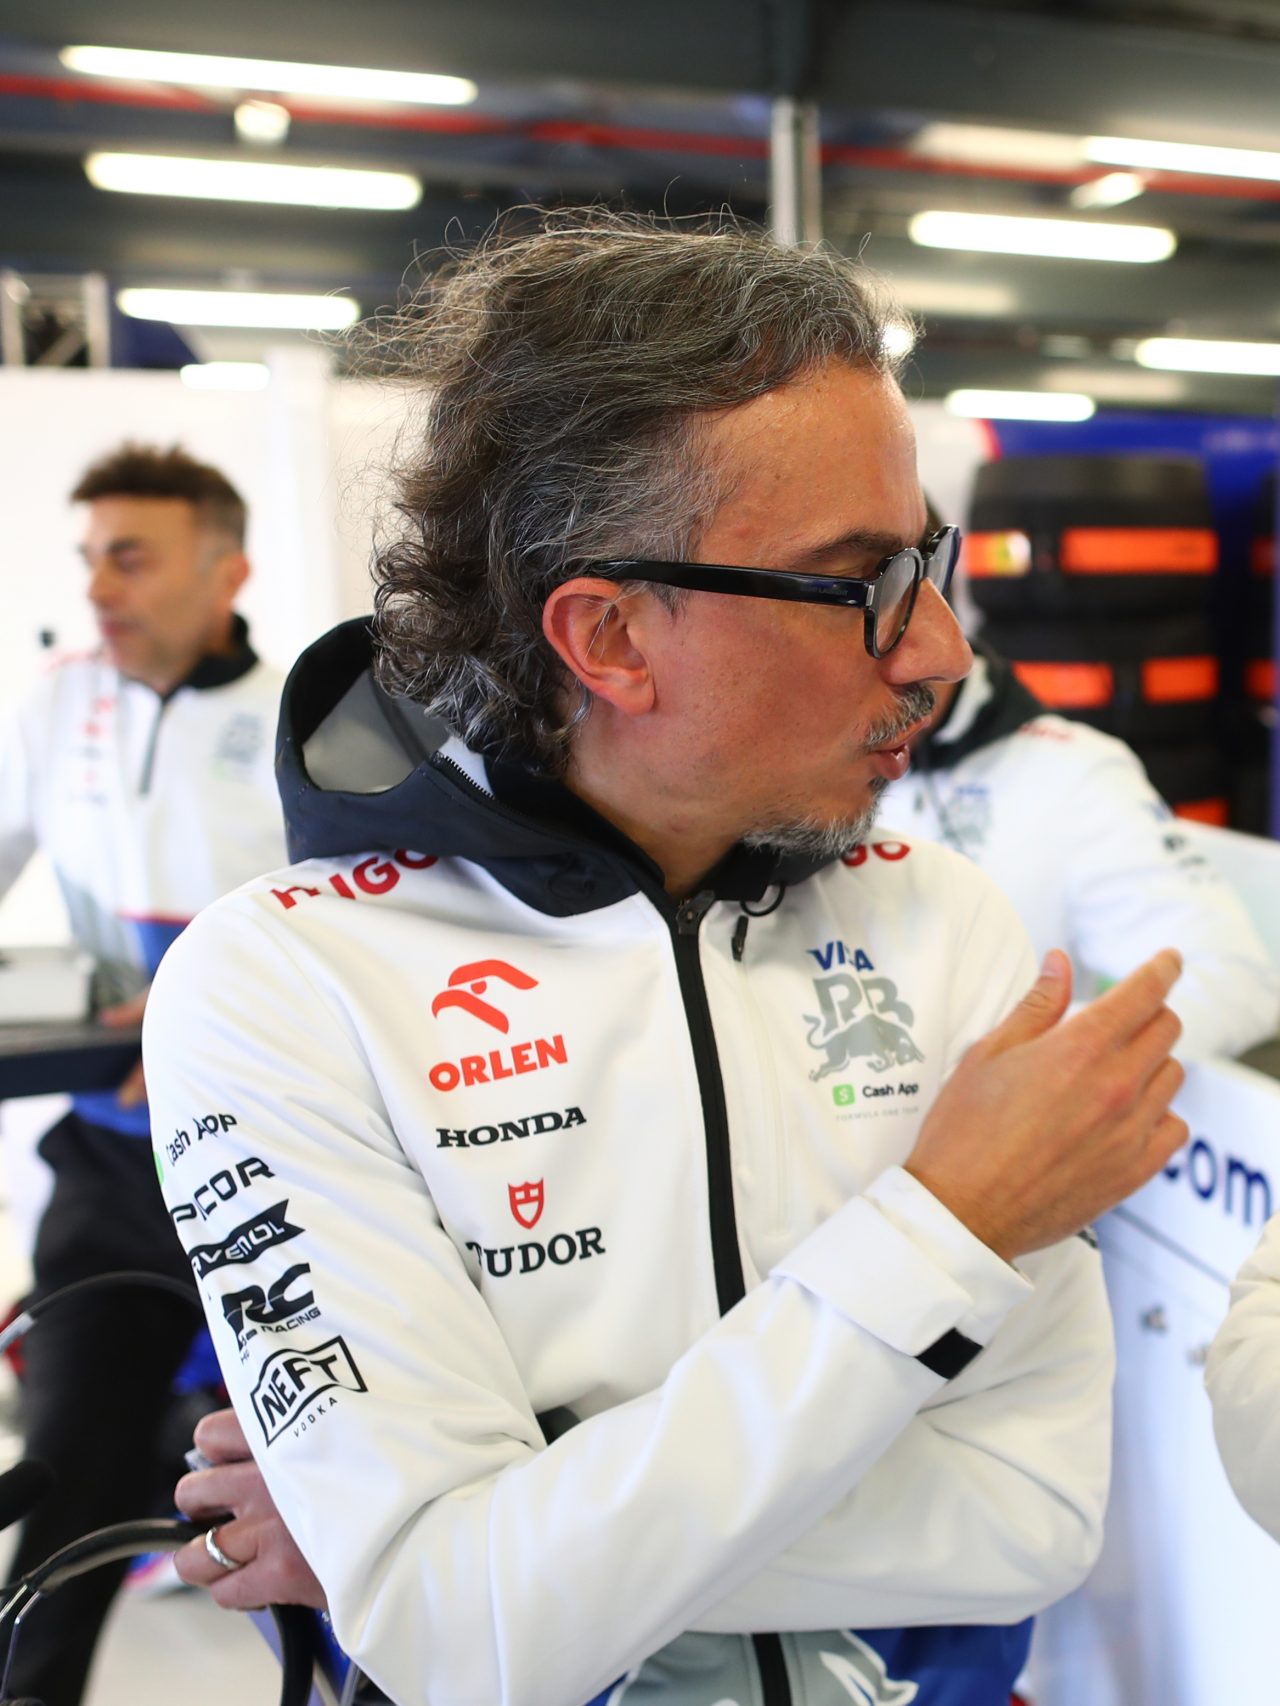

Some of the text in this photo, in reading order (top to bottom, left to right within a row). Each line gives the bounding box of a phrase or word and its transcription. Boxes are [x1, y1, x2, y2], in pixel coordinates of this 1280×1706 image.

[428, 1034, 568, 1091] ORLEN
[862, 1085, 894, 1099] Cash
[898, 1082, 919, 1096] App
[436, 1106, 587, 1148] HONDA
[261, 1354, 340, 1428] NEFT
[294, 1396, 338, 1438] VODKA
